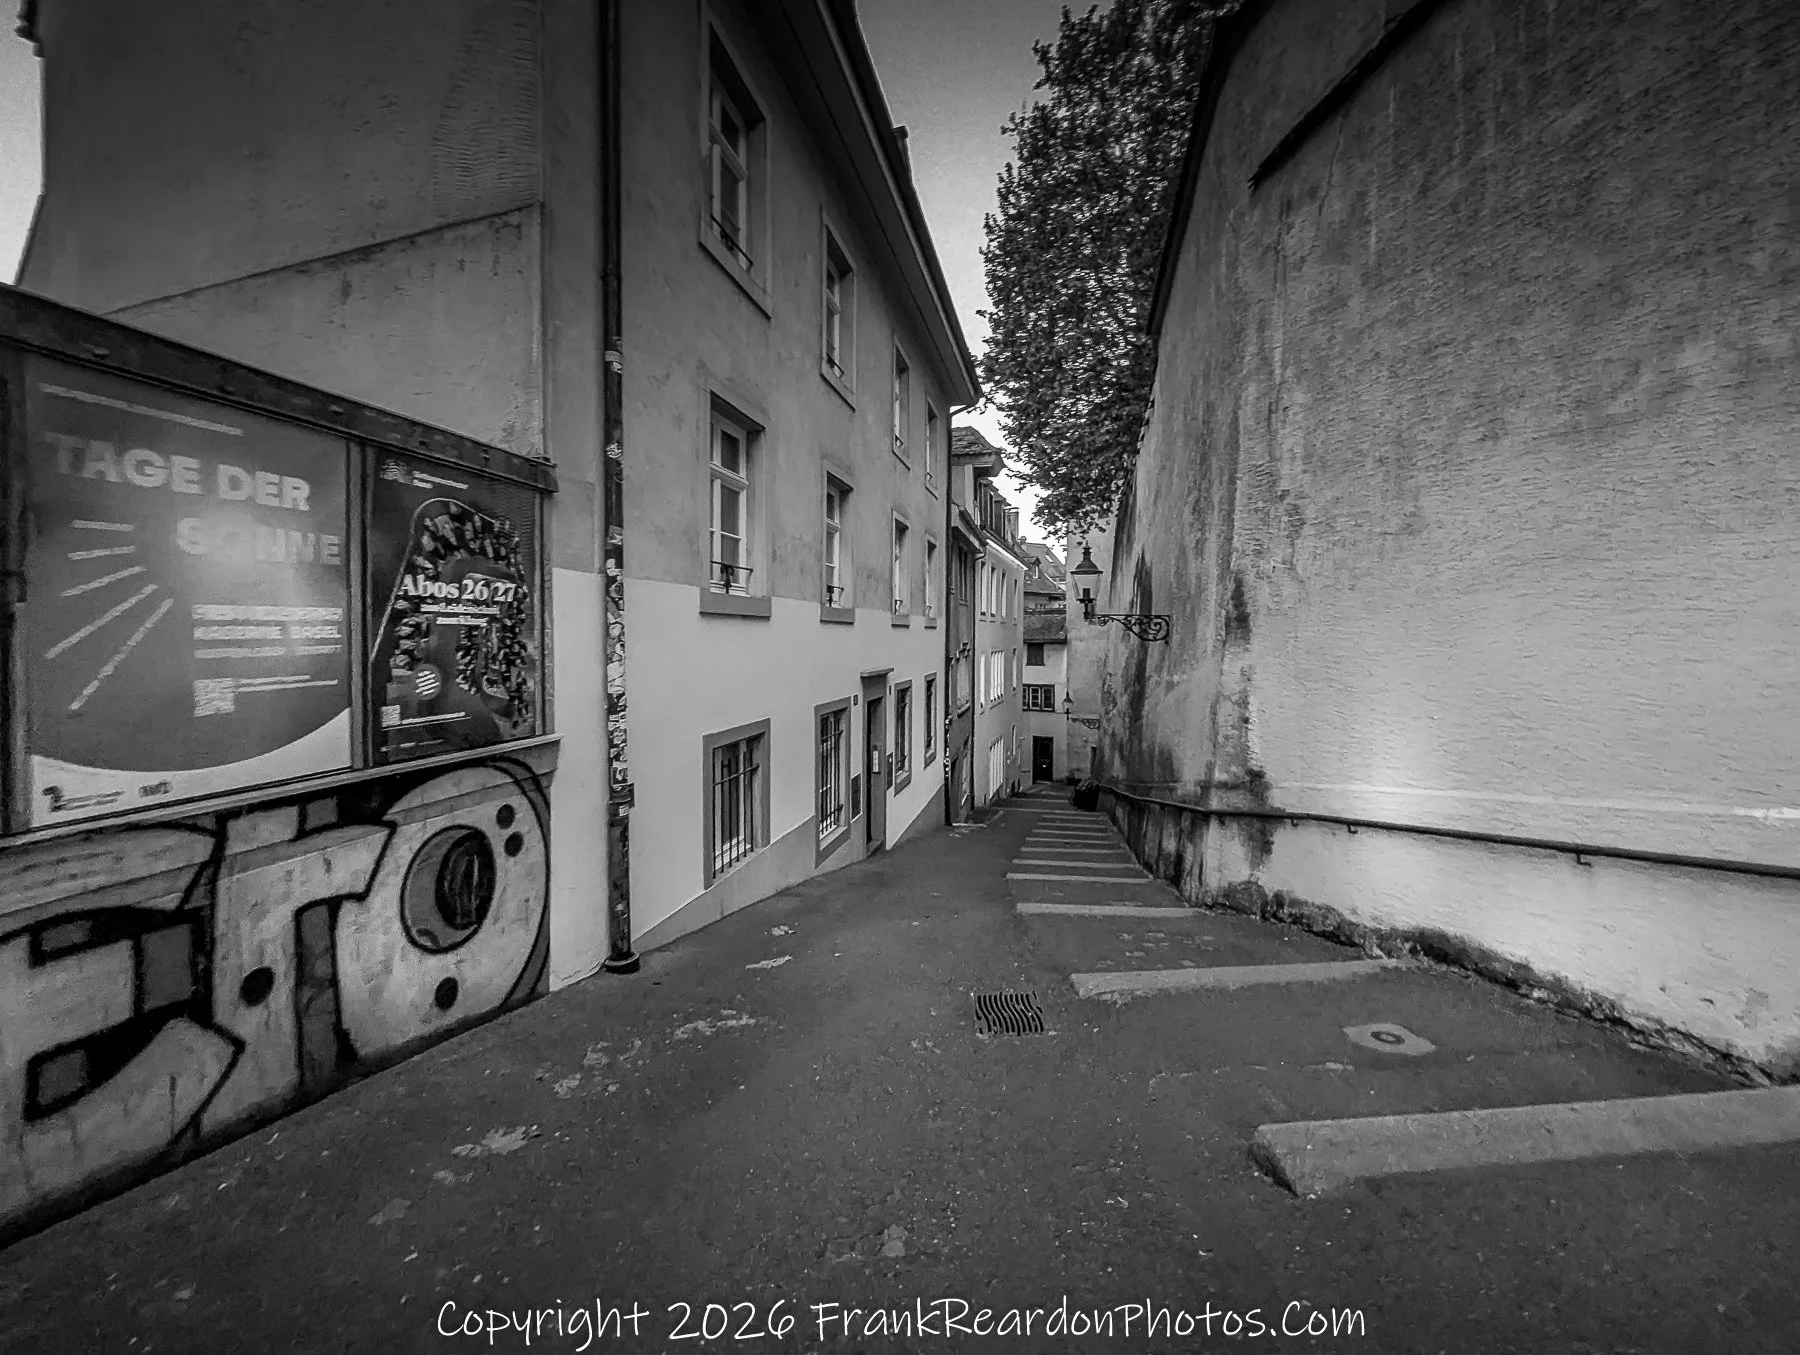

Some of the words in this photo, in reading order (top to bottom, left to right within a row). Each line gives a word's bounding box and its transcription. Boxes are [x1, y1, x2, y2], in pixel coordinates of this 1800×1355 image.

[45, 431, 203, 496] TAGE
[217, 463, 311, 511] DER
[397, 574, 460, 599] Abos
